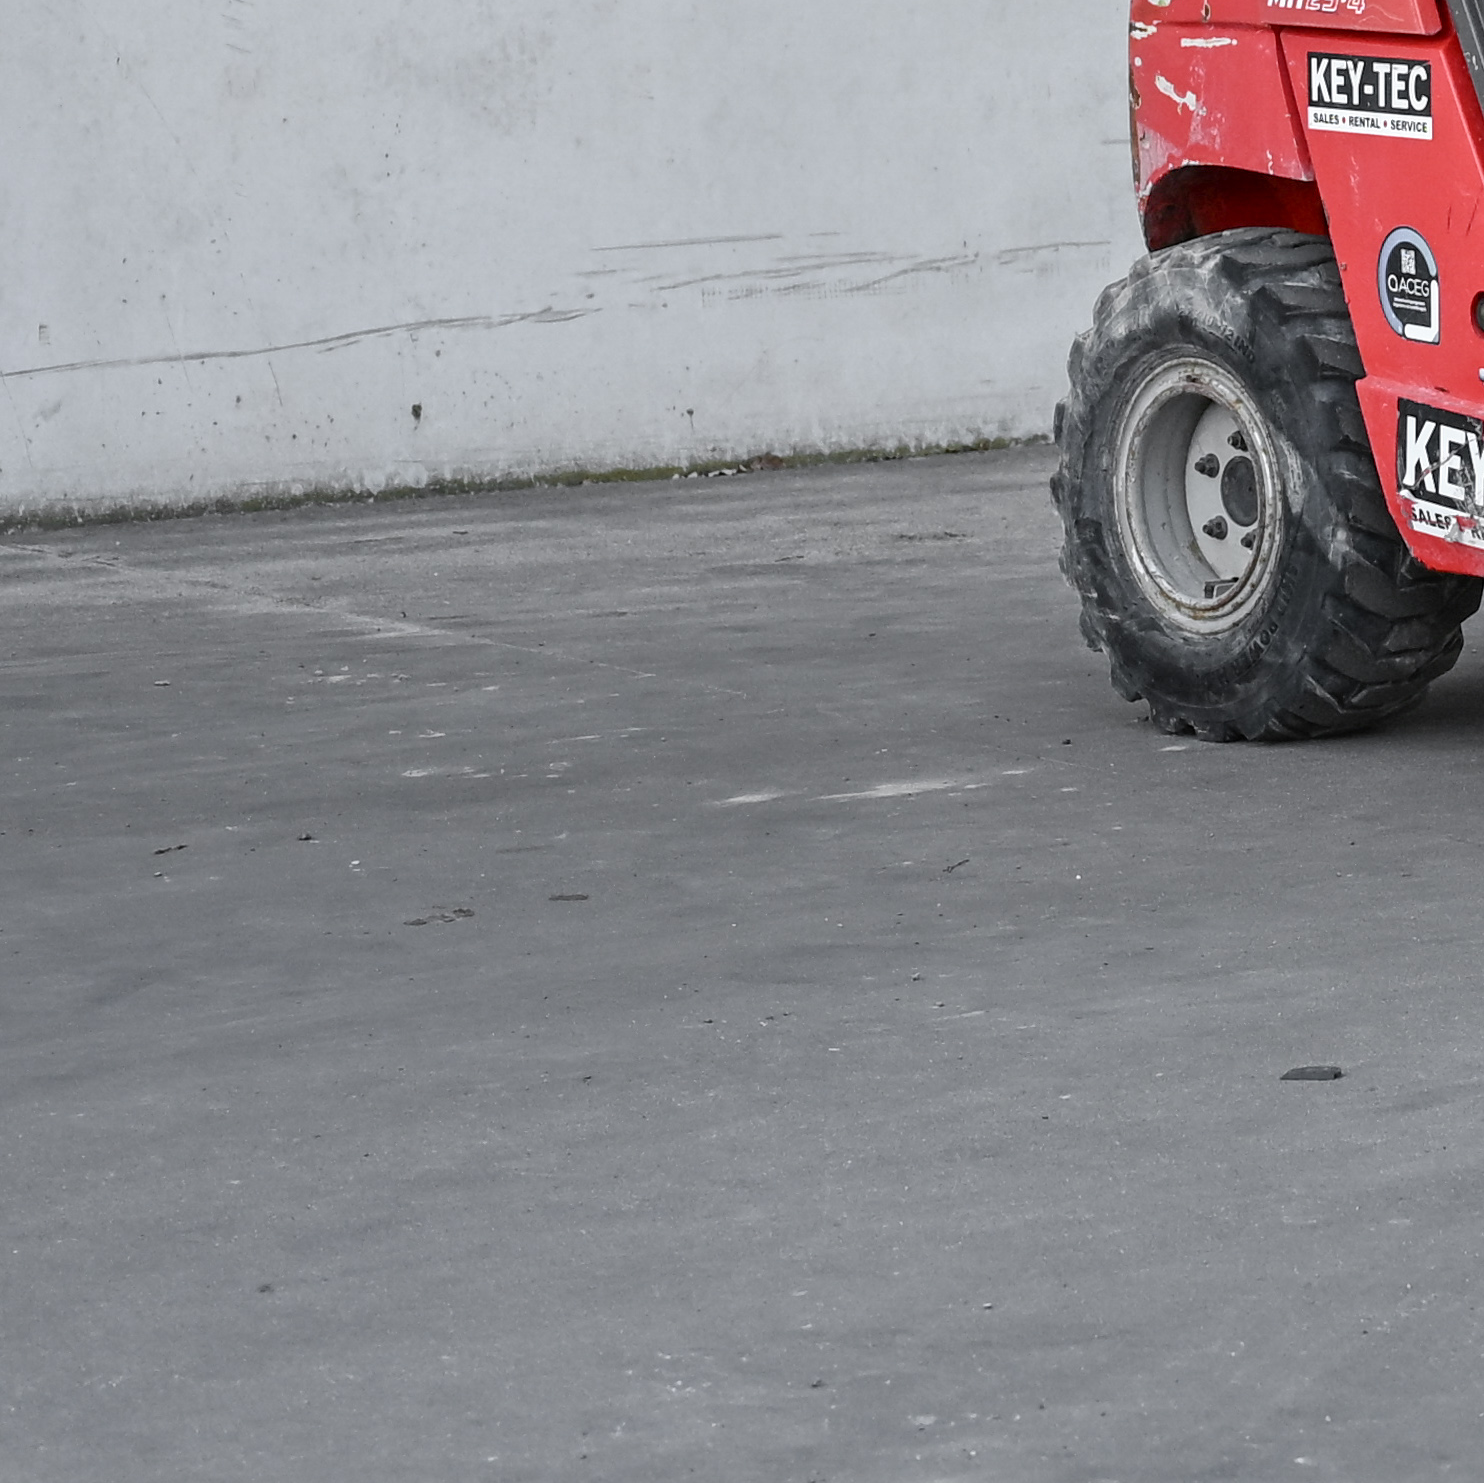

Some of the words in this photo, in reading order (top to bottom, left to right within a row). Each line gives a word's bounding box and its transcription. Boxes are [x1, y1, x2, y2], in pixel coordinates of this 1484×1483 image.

[1311, 57, 1429, 111] KEY-TEC
[1313, 113, 1340, 125] SALES
[1349, 116, 1380, 129] RENTAL
[1390, 120, 1428, 133] SERVICE
